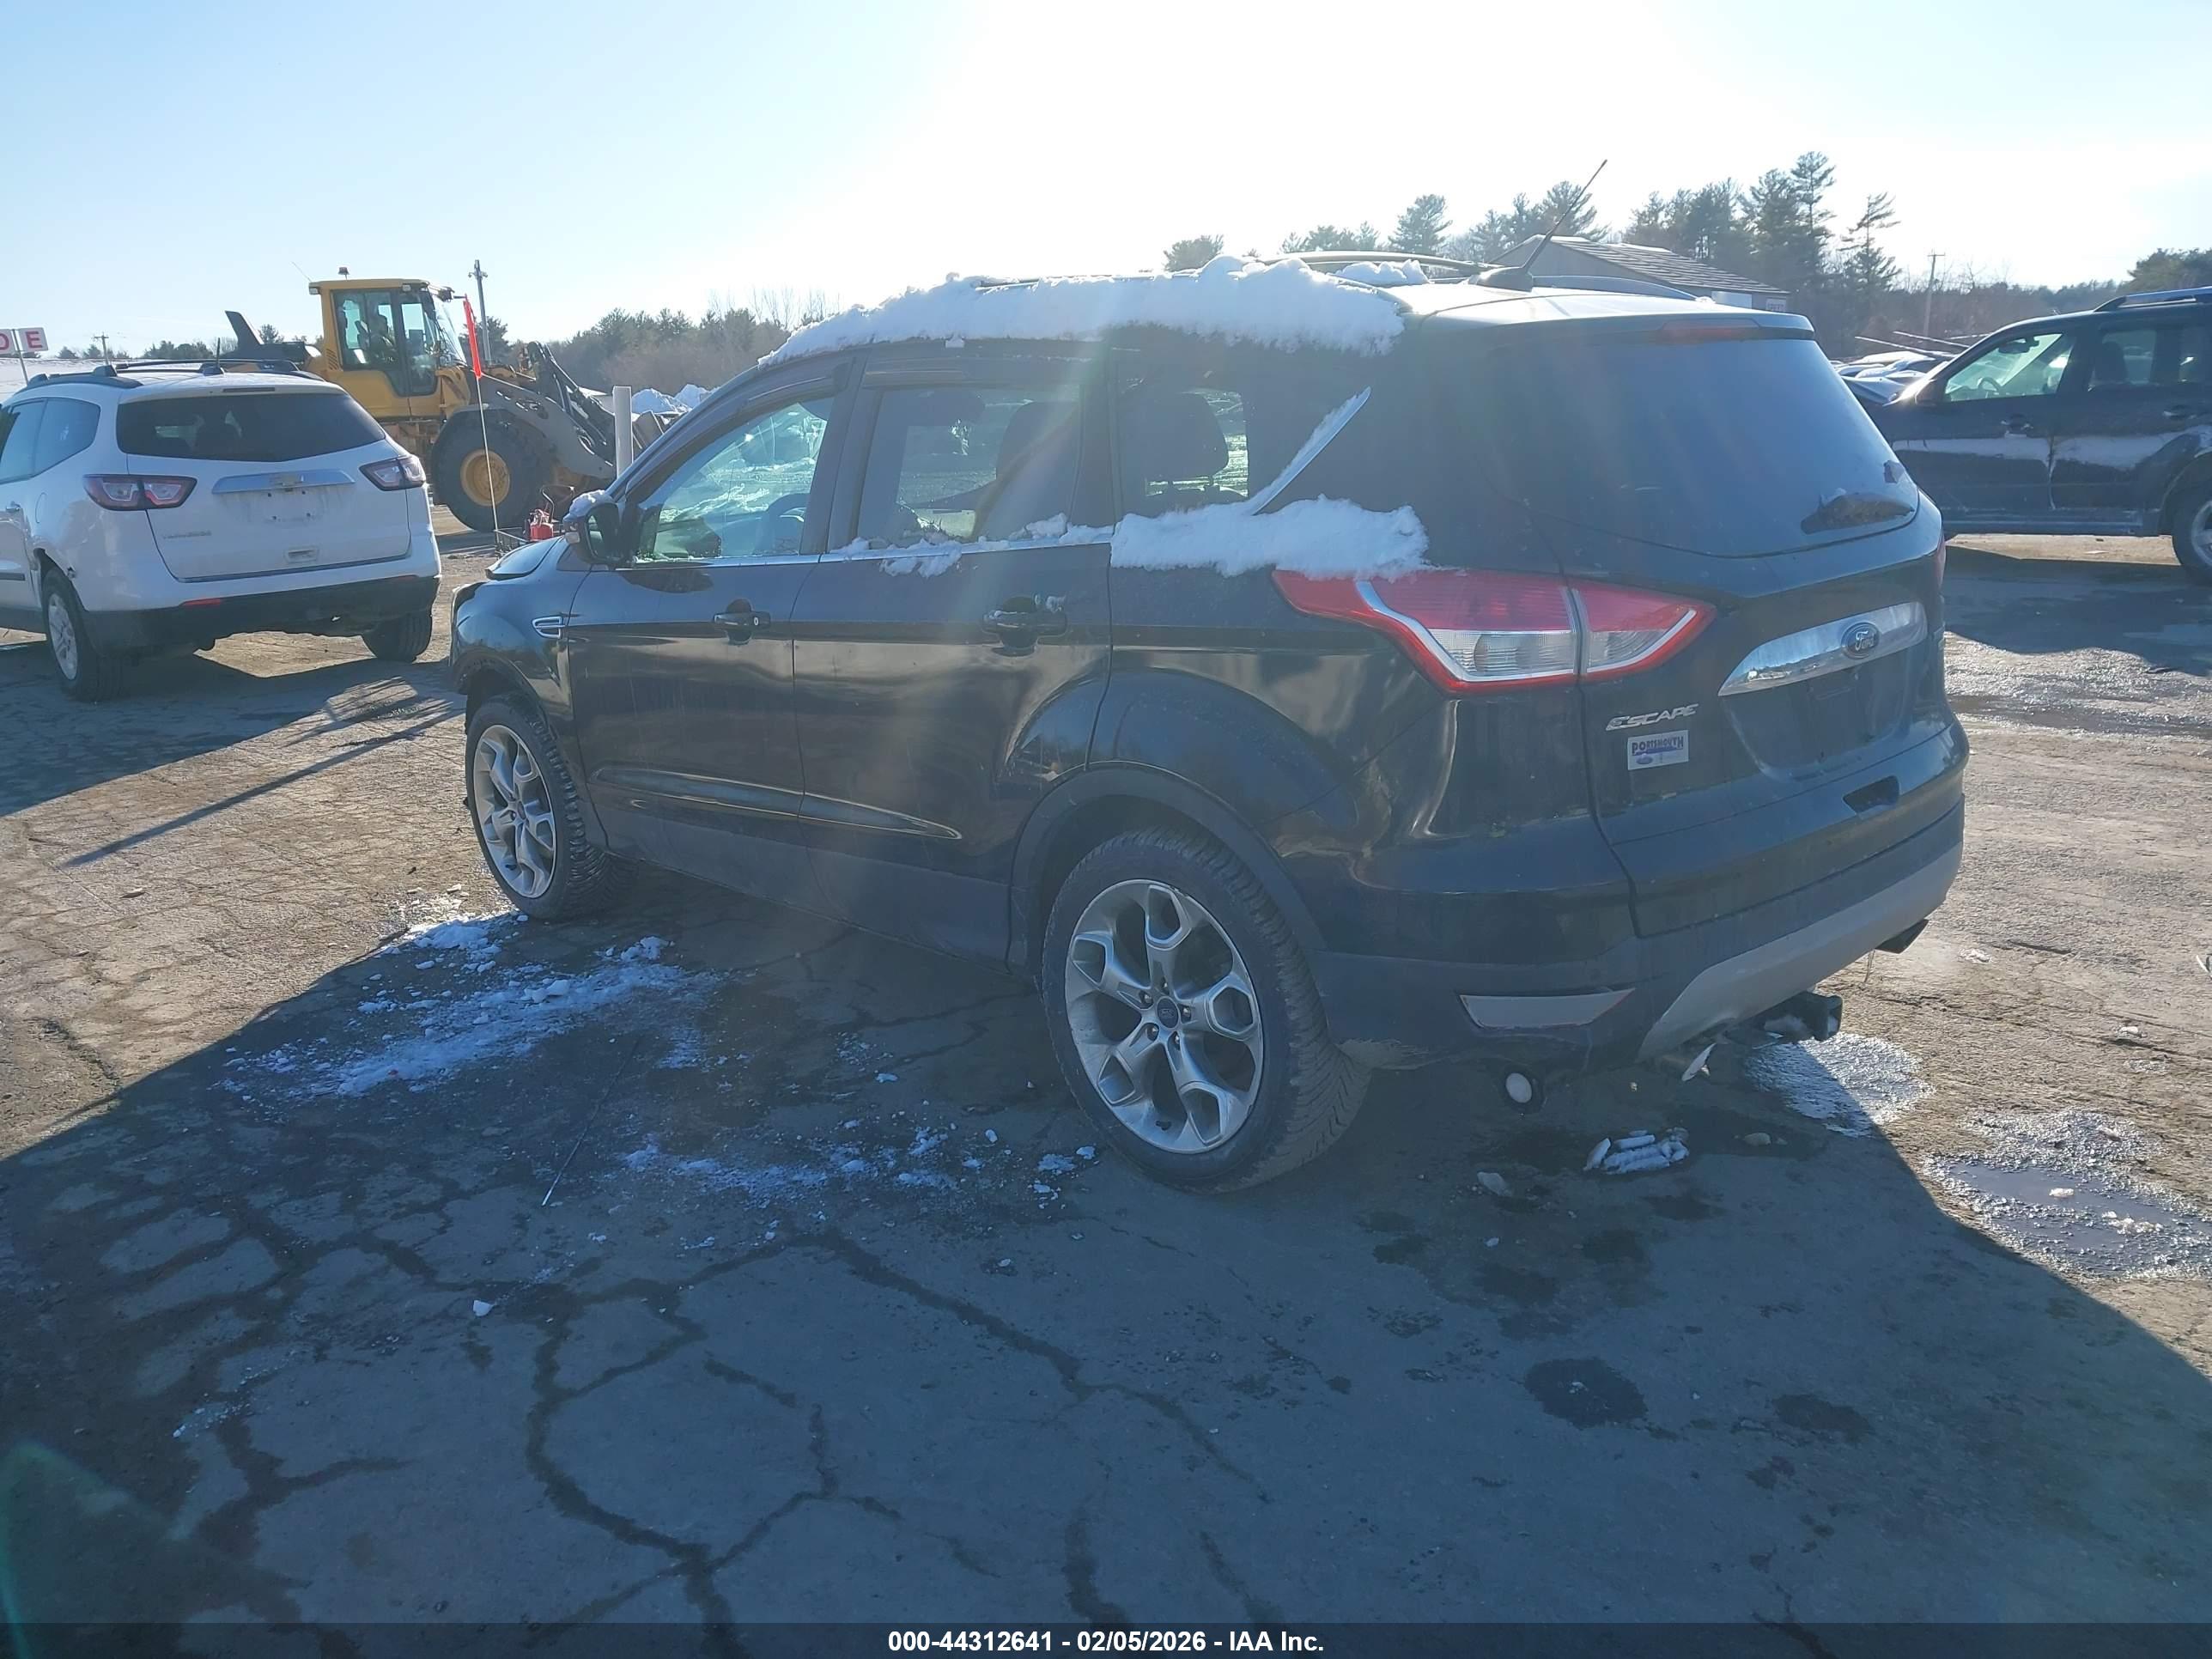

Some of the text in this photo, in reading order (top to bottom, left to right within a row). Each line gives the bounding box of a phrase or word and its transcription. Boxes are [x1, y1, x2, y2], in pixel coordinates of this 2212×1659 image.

[26, 331, 43, 349] E
[1855, 630, 1875, 651] Ford
[1605, 703, 1699, 731] ESCAPE
